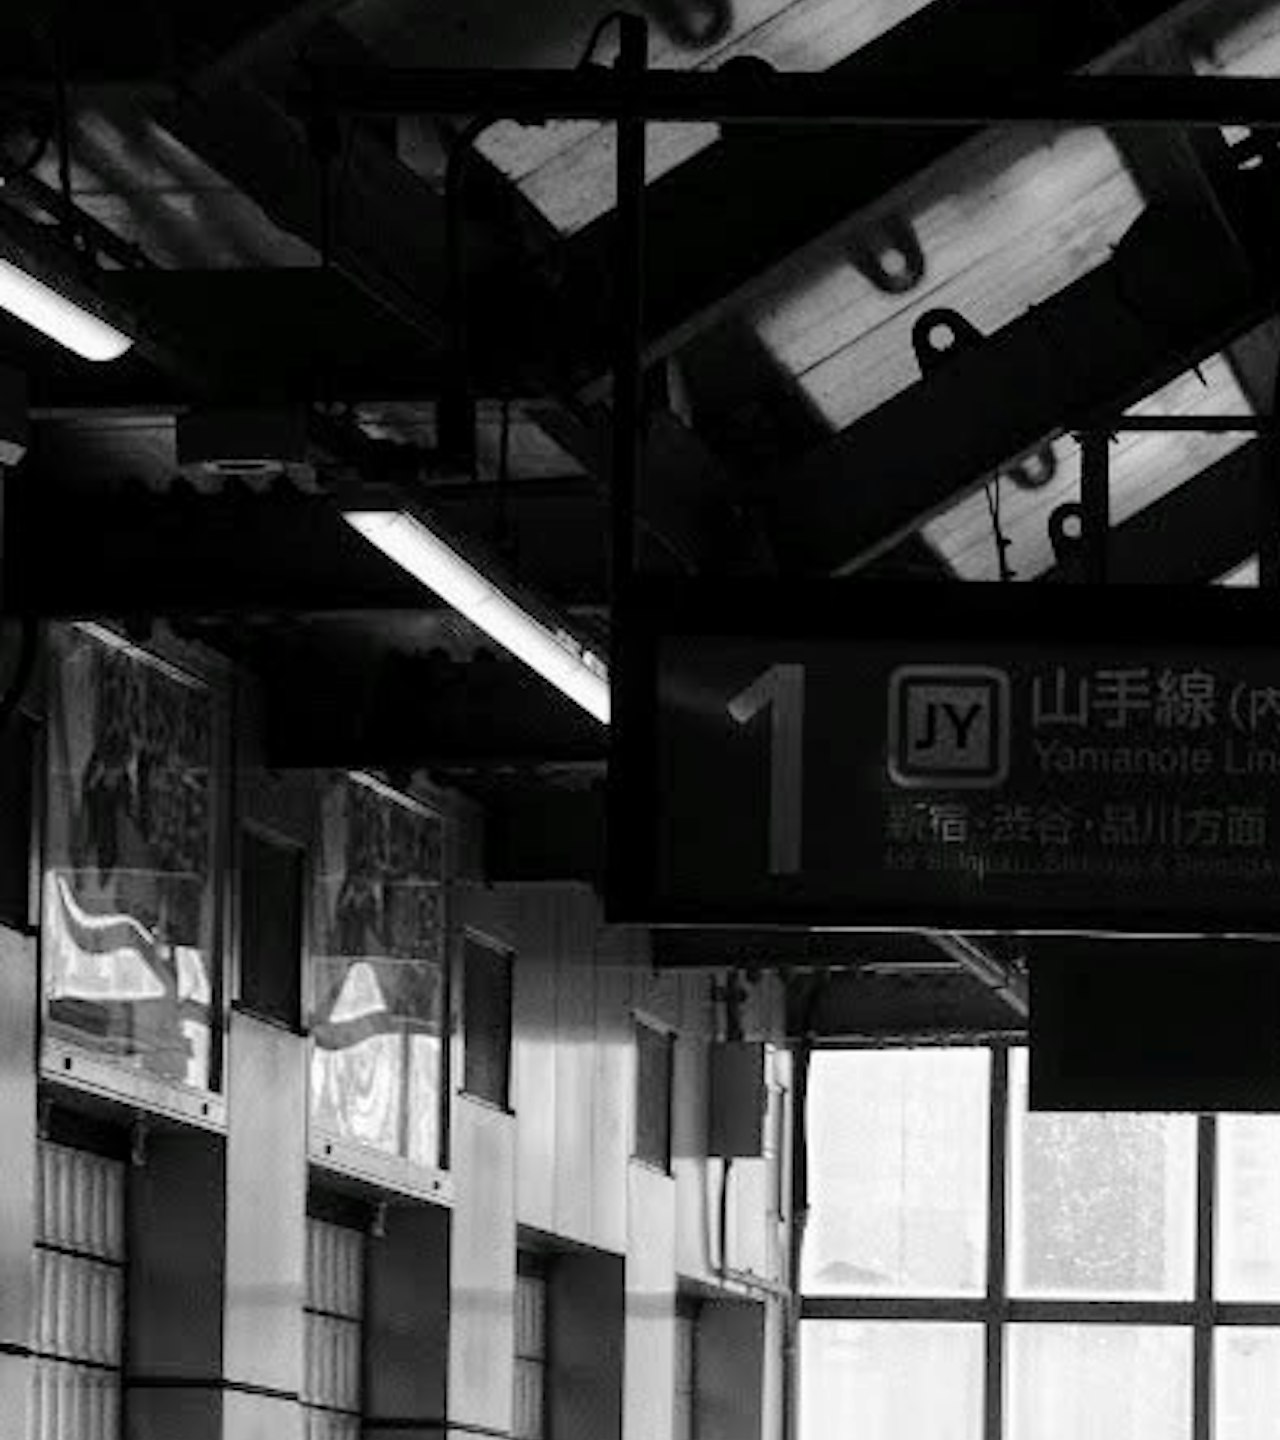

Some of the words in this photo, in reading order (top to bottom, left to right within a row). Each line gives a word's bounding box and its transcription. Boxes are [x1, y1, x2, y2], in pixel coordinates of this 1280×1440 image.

[914, 703, 981, 749] JY
[727, 662, 806, 875] 1
[1032, 739, 1214, 776] Yamanote
